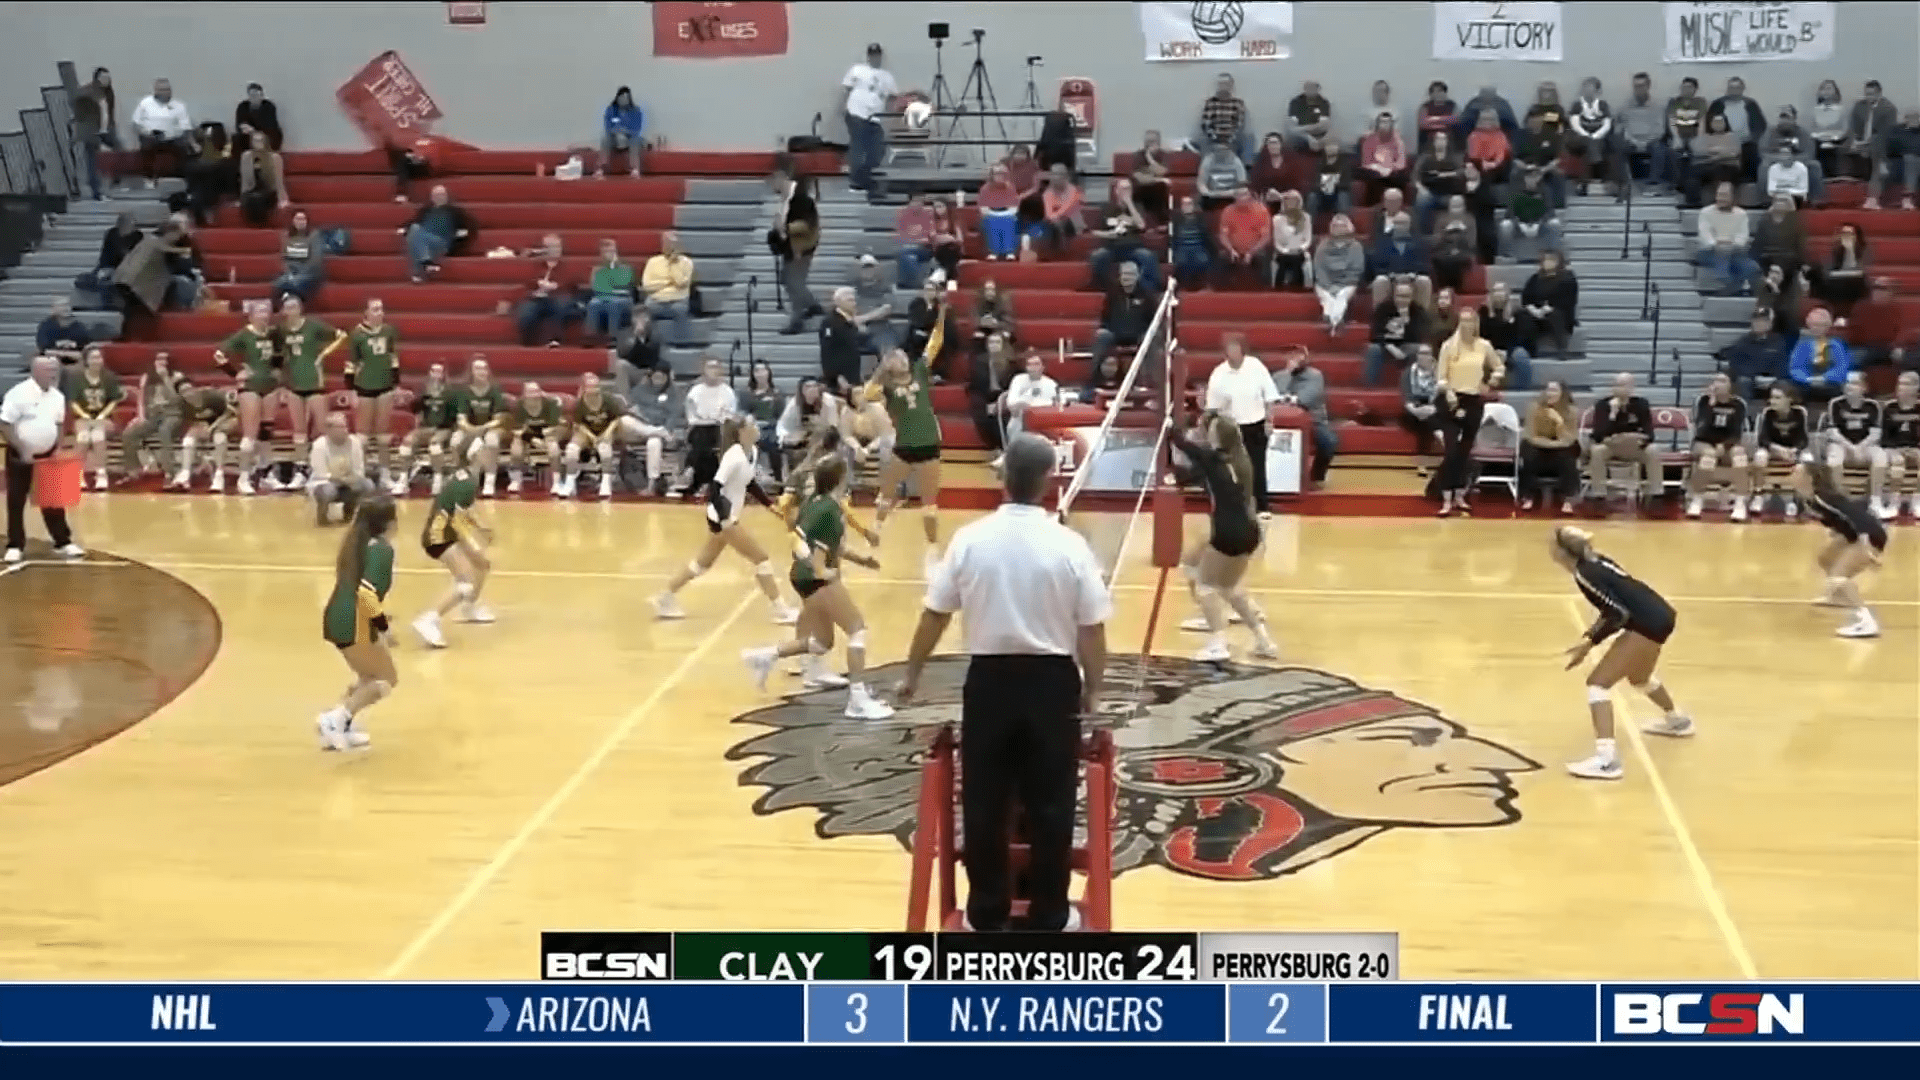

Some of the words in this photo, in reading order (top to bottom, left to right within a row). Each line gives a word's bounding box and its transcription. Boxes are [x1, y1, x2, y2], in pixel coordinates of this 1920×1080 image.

[1750, 9, 1789, 29] LIFE
[1456, 22, 1555, 49] VICTORY
[1680, 11, 1742, 58] MUSIC
[1747, 33, 1797, 53] WOULD
[1160, 41, 1201, 57] WORK
[1240, 40, 1276, 56] HARD
